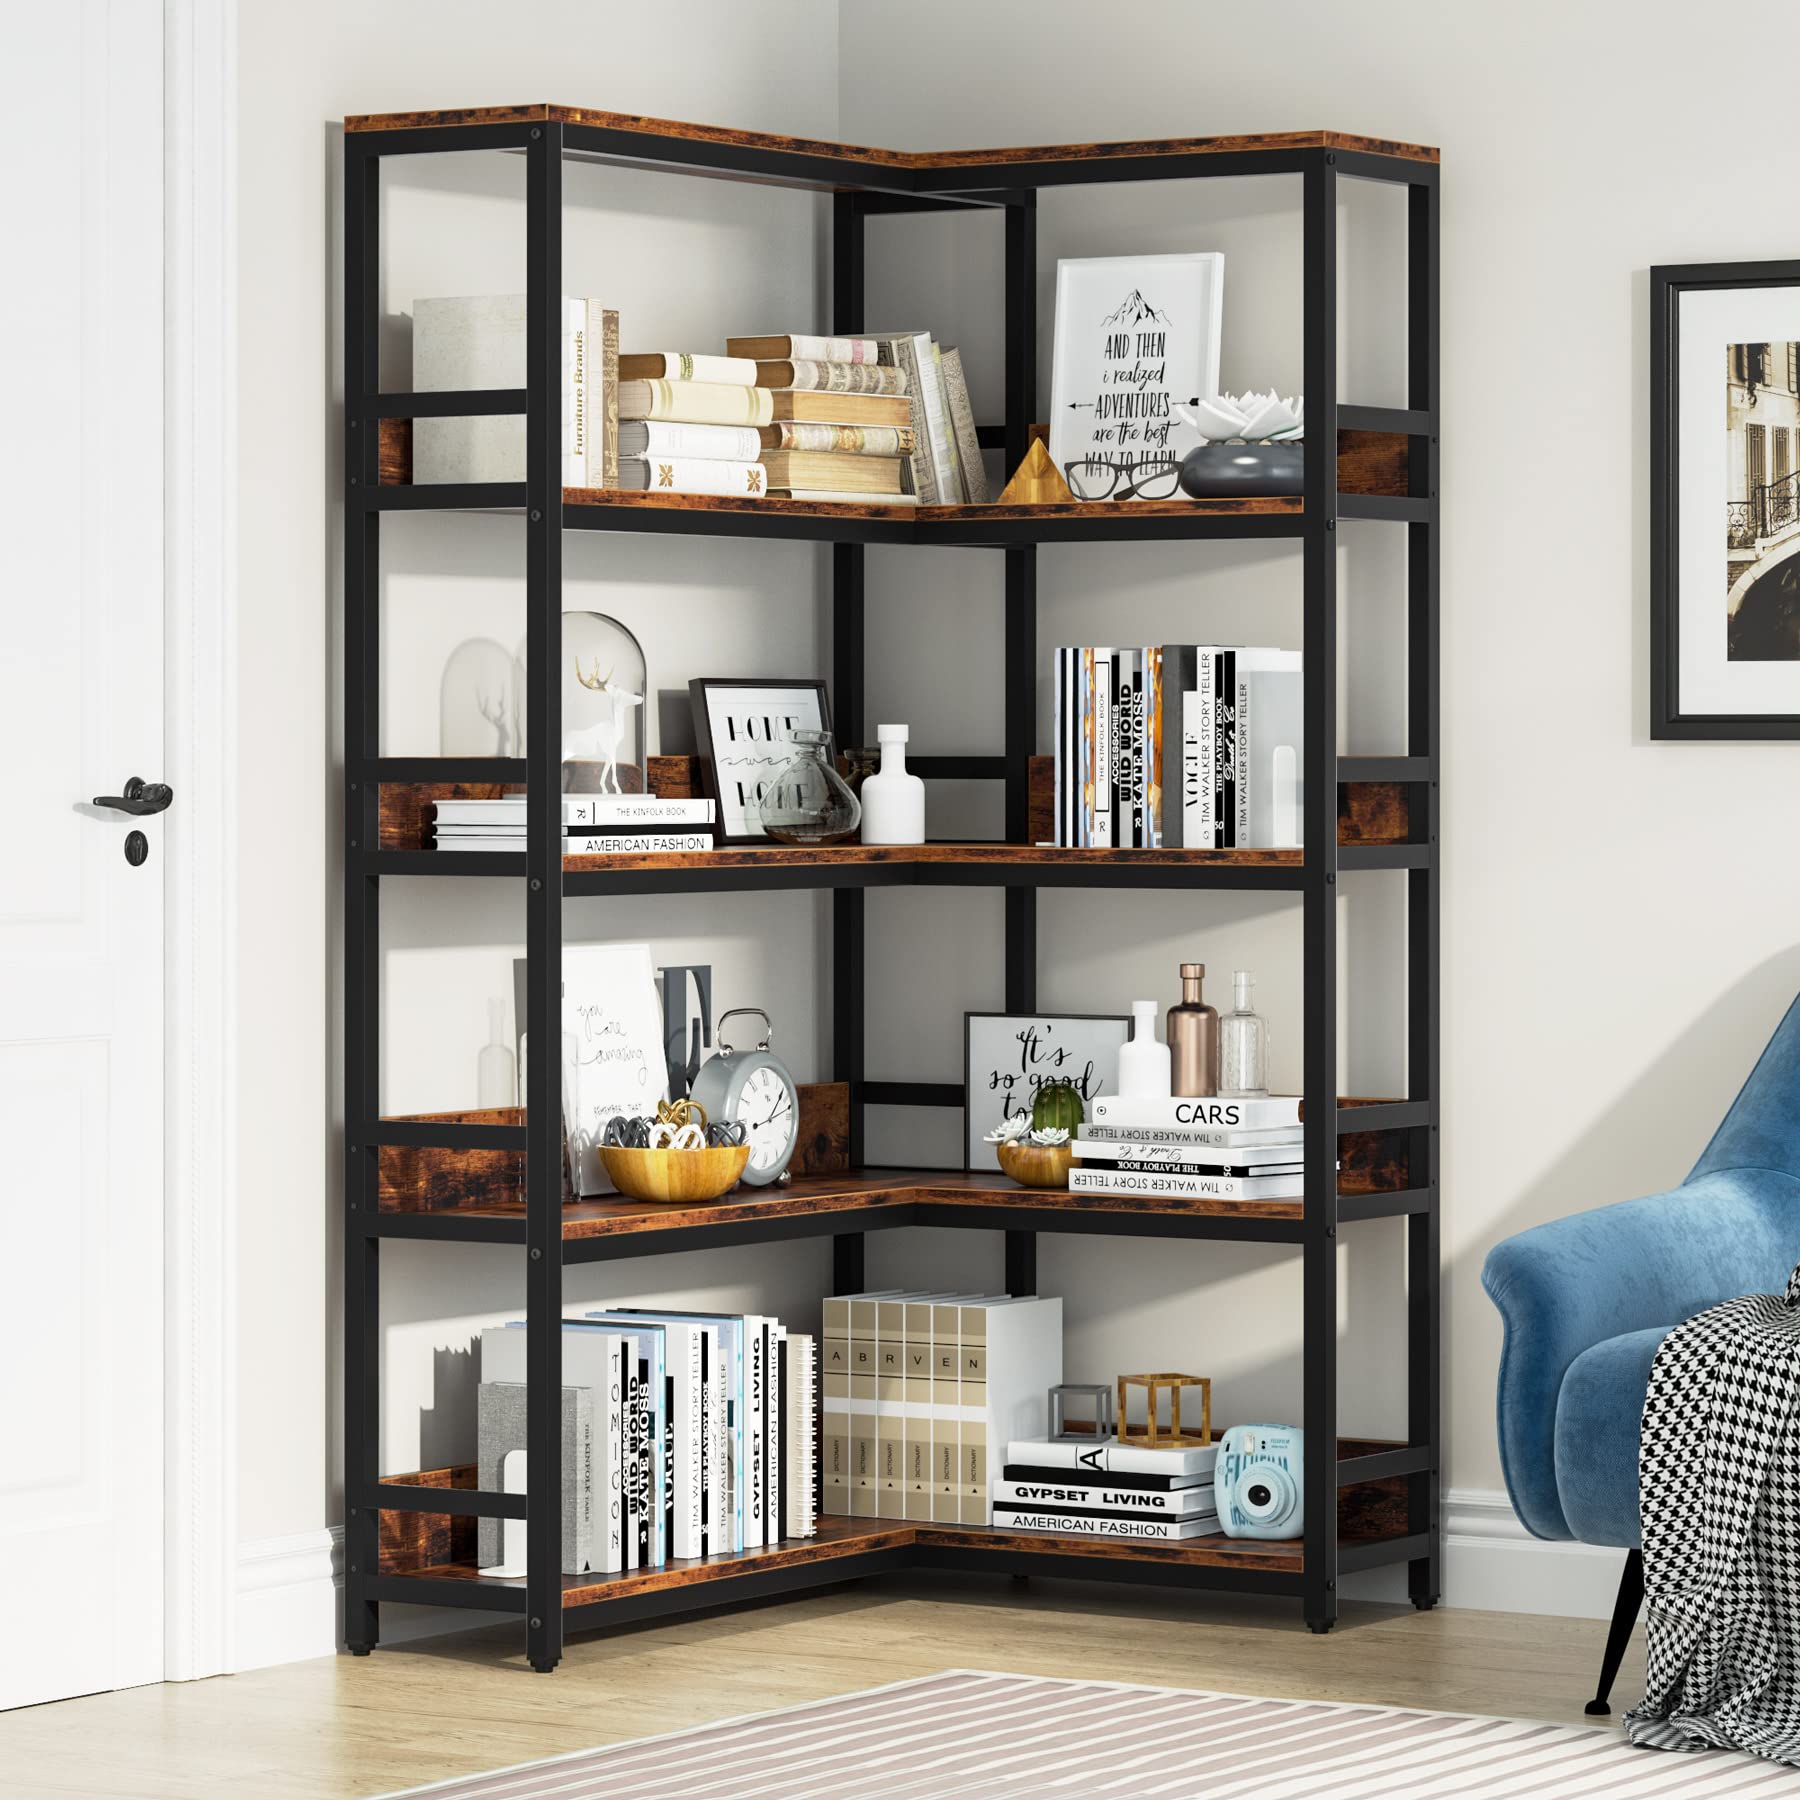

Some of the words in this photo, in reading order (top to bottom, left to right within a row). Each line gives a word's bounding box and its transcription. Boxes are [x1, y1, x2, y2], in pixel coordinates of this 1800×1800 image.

[574, 330, 583, 384] Brands
[1104, 333, 1130, 360] AND
[1136, 332, 1166, 358] THEN
[1103, 370, 1110, 384] i
[1114, 360, 1166, 391] realized
[1094, 392, 1170, 420] ADVENTURES
[574, 388, 583, 456] Furniture
[1092, 428, 1116, 443] are
[1112, 421, 1140, 446] the
[1144, 420, 1181, 449] best
[1085, 451, 1114, 478] WAY
[1202, 653, 1210, 696] TELLER
[1120, 684, 1132, 750] WORLD
[1133, 691, 1142, 750] MOSS
[1202, 699, 1210, 742] STORY
[1112, 704, 1120, 785] ACCESSORIES
[1120, 756, 1132, 802] WILD
[1133, 754, 1142, 810] KATE
[1202, 744, 1210, 798] WALKER
[616, 808, 630, 816] THE
[633, 808, 664, 816] KINFOLK
[666, 807, 687, 816] BOOK
[1202, 802, 1210, 824] TIM
[586, 839, 650, 852] AMERICAN
[654, 837, 705, 850] FASHION
[571, 1045, 648, 1086] amazing
[988, 1070, 1022, 1090] so
[1028, 1060, 1104, 1108] good
[1176, 1104, 1240, 1125] CARS
[1088, 1128, 1118, 1138] TELLER
[1121, 1130, 1150, 1140] STORY
[1152, 1131, 1192, 1142] WALKER
[1194, 1134, 1210, 1144] TIM
[1117, 1160, 1140, 1170] BOOK
[1142, 1162, 1181, 1173] PLAYBOY
[1182, 1164, 1200, 1174] THE
[1074, 1174, 1110, 1187] TELLER
[1113, 1176, 1148, 1190] STORY
[1151, 1178, 1197, 1192] WALKER
[1200, 1182, 1220, 1194] TIM
[832, 1352, 840, 1360] A
[860, 1353, 866, 1362] B
[886, 1354, 894, 1364] R
[914, 1356, 922, 1365] V
[942, 1358, 950, 1366] E
[970, 1360, 978, 1368] N
[630, 1376, 638, 1452] WORLD
[639, 1383, 649, 1452] MOSS
[1080, 1448, 1104, 1470] A
[630, 1462, 638, 1516] WILD
[639, 1456, 649, 1524] KATE
[1015, 1486, 1090, 1502] GYPSET
[1102, 1492, 1166, 1508] LIVING
[1012, 1516, 1094, 1532] AMERICAN
[1100, 1521, 1168, 1536] FASHION
